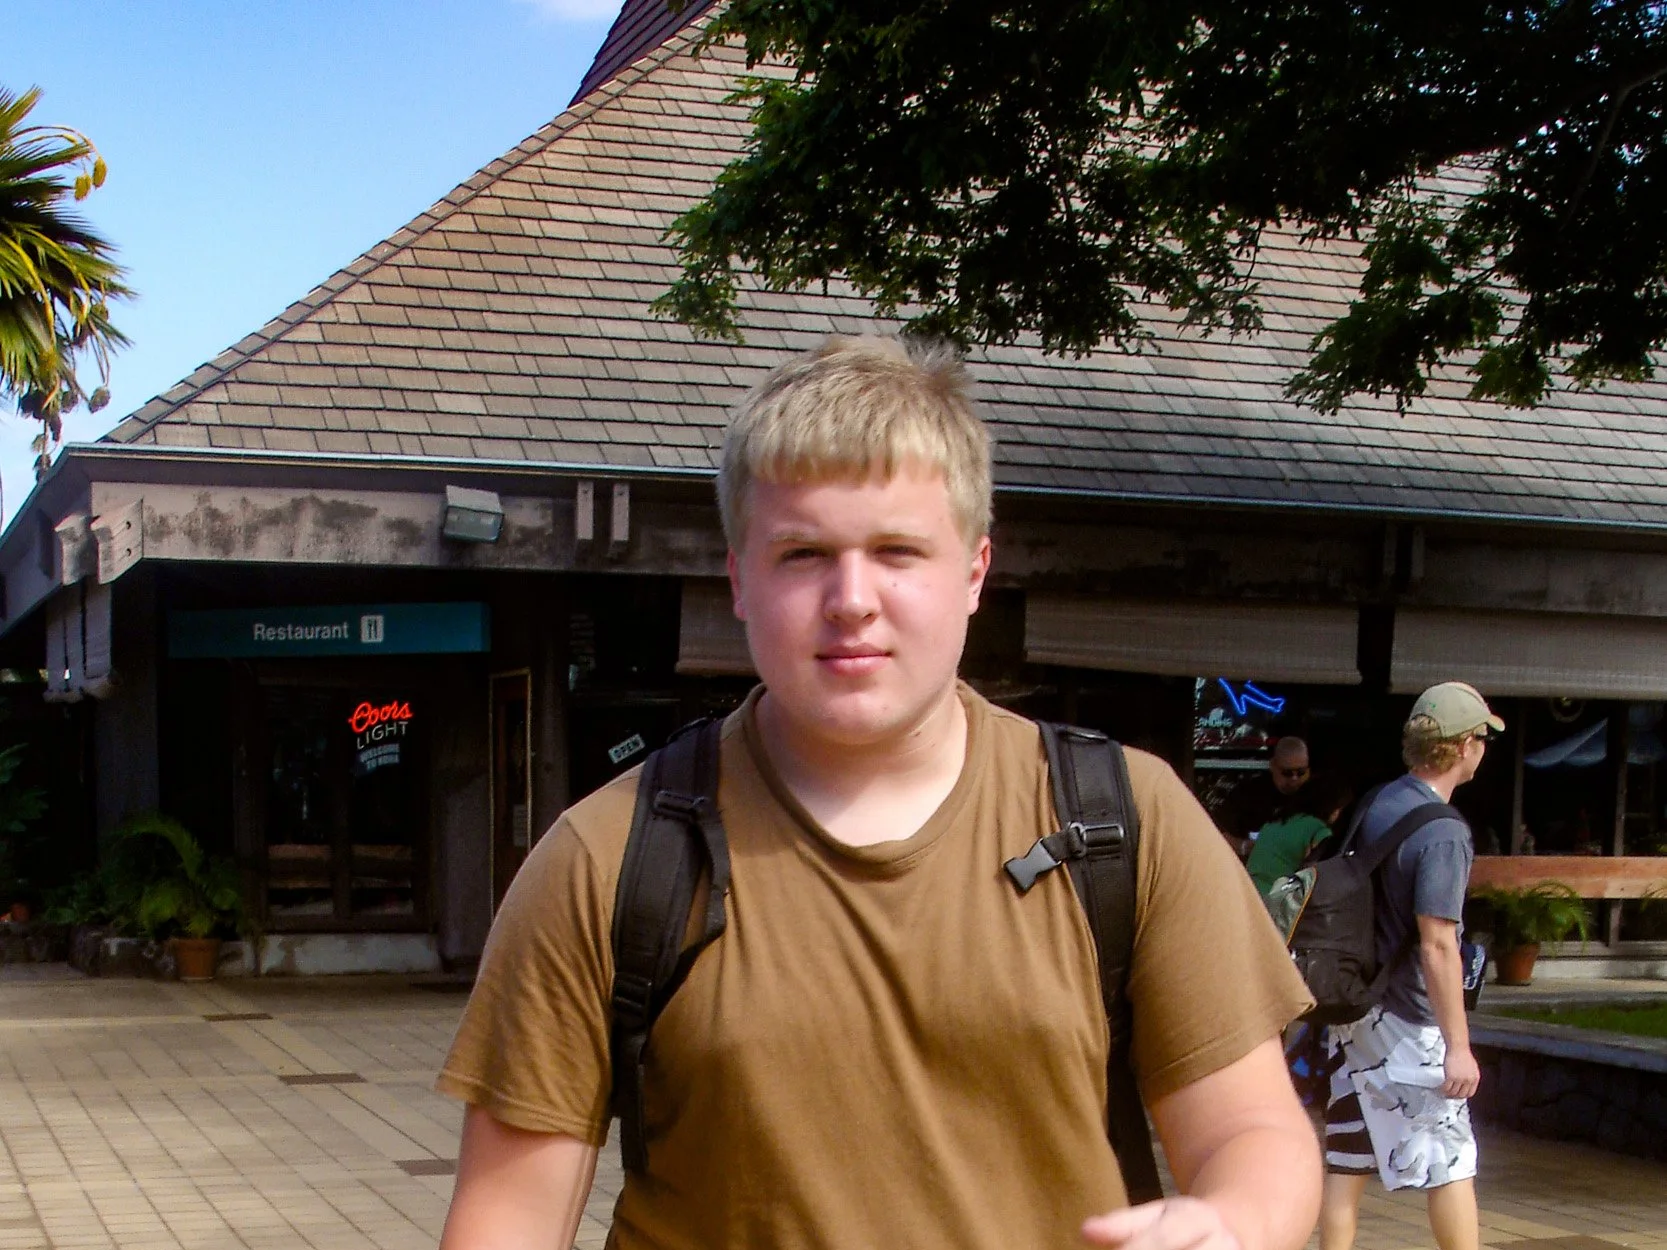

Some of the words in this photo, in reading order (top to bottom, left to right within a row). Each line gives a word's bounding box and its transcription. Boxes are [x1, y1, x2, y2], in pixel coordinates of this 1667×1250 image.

[253, 621, 349, 641] Restaurant
[348, 700, 413, 733] Coors
[356, 721, 409, 750] LIGHT
[613, 739, 641, 759] OPEN
